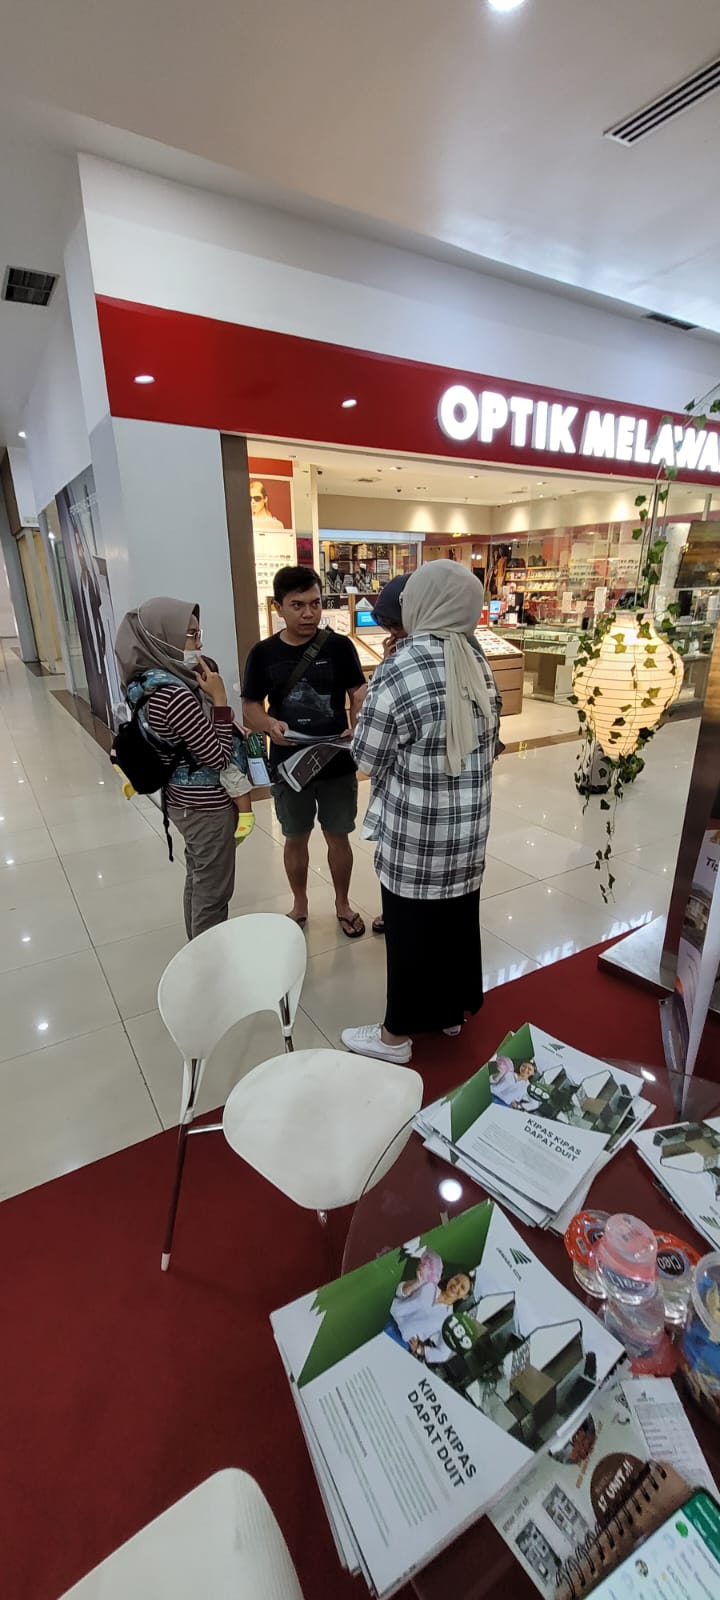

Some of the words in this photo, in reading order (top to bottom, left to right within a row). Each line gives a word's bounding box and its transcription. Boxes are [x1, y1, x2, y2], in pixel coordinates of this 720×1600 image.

[437, 385, 579, 454] OPTIK
[580, 410, 720, 473] MELAWA
[524, 1126, 555, 1147] DAPAT
[555, 1146, 578, 1162] DUIT
[527, 1118, 554, 1138] KIPAS
[554, 1136, 582, 1156] KIPAS
[657, 1255, 681, 1271] Cleo
[448, 1316, 473, 1350] 189
[407, 1390, 442, 1445] DAPAT
[436, 1445, 465, 1488] DUIT
[418, 1377, 448, 1425] KIPAS
[444, 1425, 477, 1478] KIPAS
